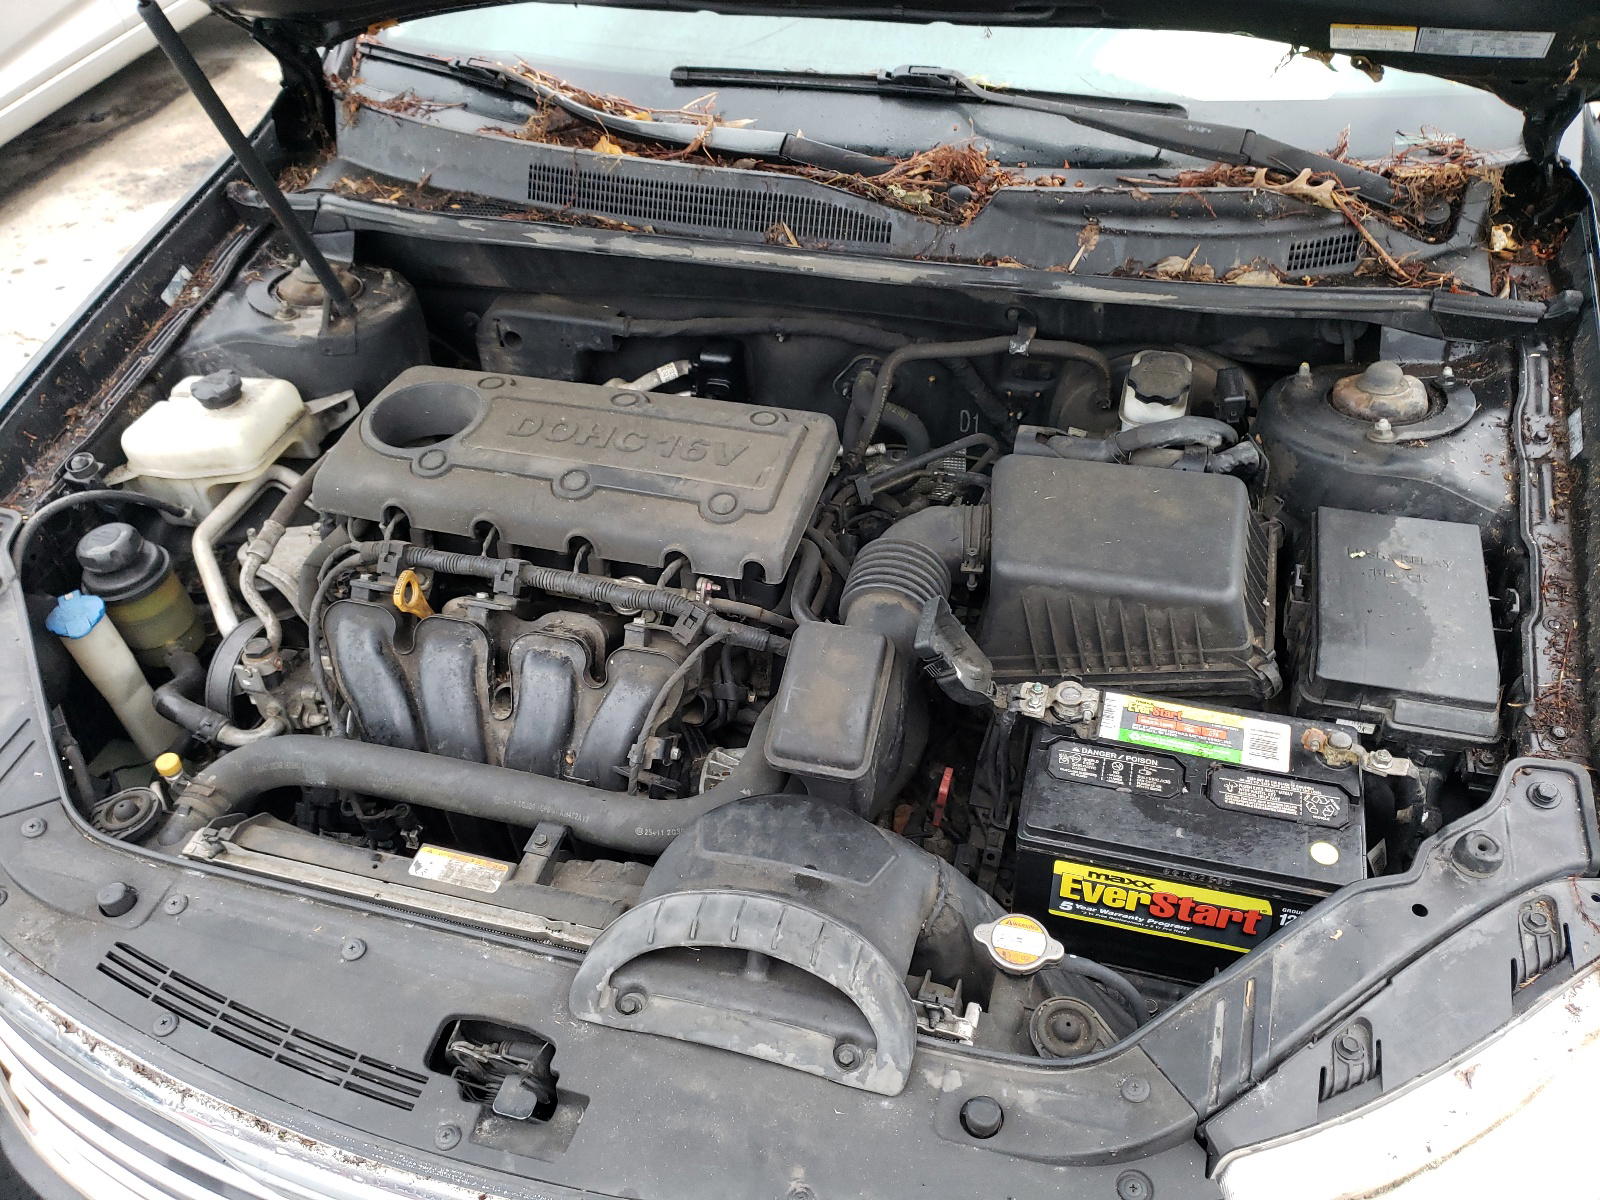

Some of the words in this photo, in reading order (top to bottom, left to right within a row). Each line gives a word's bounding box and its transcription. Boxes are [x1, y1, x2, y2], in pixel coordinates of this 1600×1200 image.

[960, 409, 979, 433] D1
[506, 417, 648, 452] DOHC
[656, 436, 749, 467] 16V
[1081, 747, 1117, 760] DANGER
[1126, 755, 1159, 767] POISON
[1088, 870, 1155, 891] maxx
[1059, 901, 1074, 911] 5
[1075, 903, 1098, 913] Year
[1099, 908, 1146, 923] Warranty
[1060, 872, 1263, 935] EverStart
